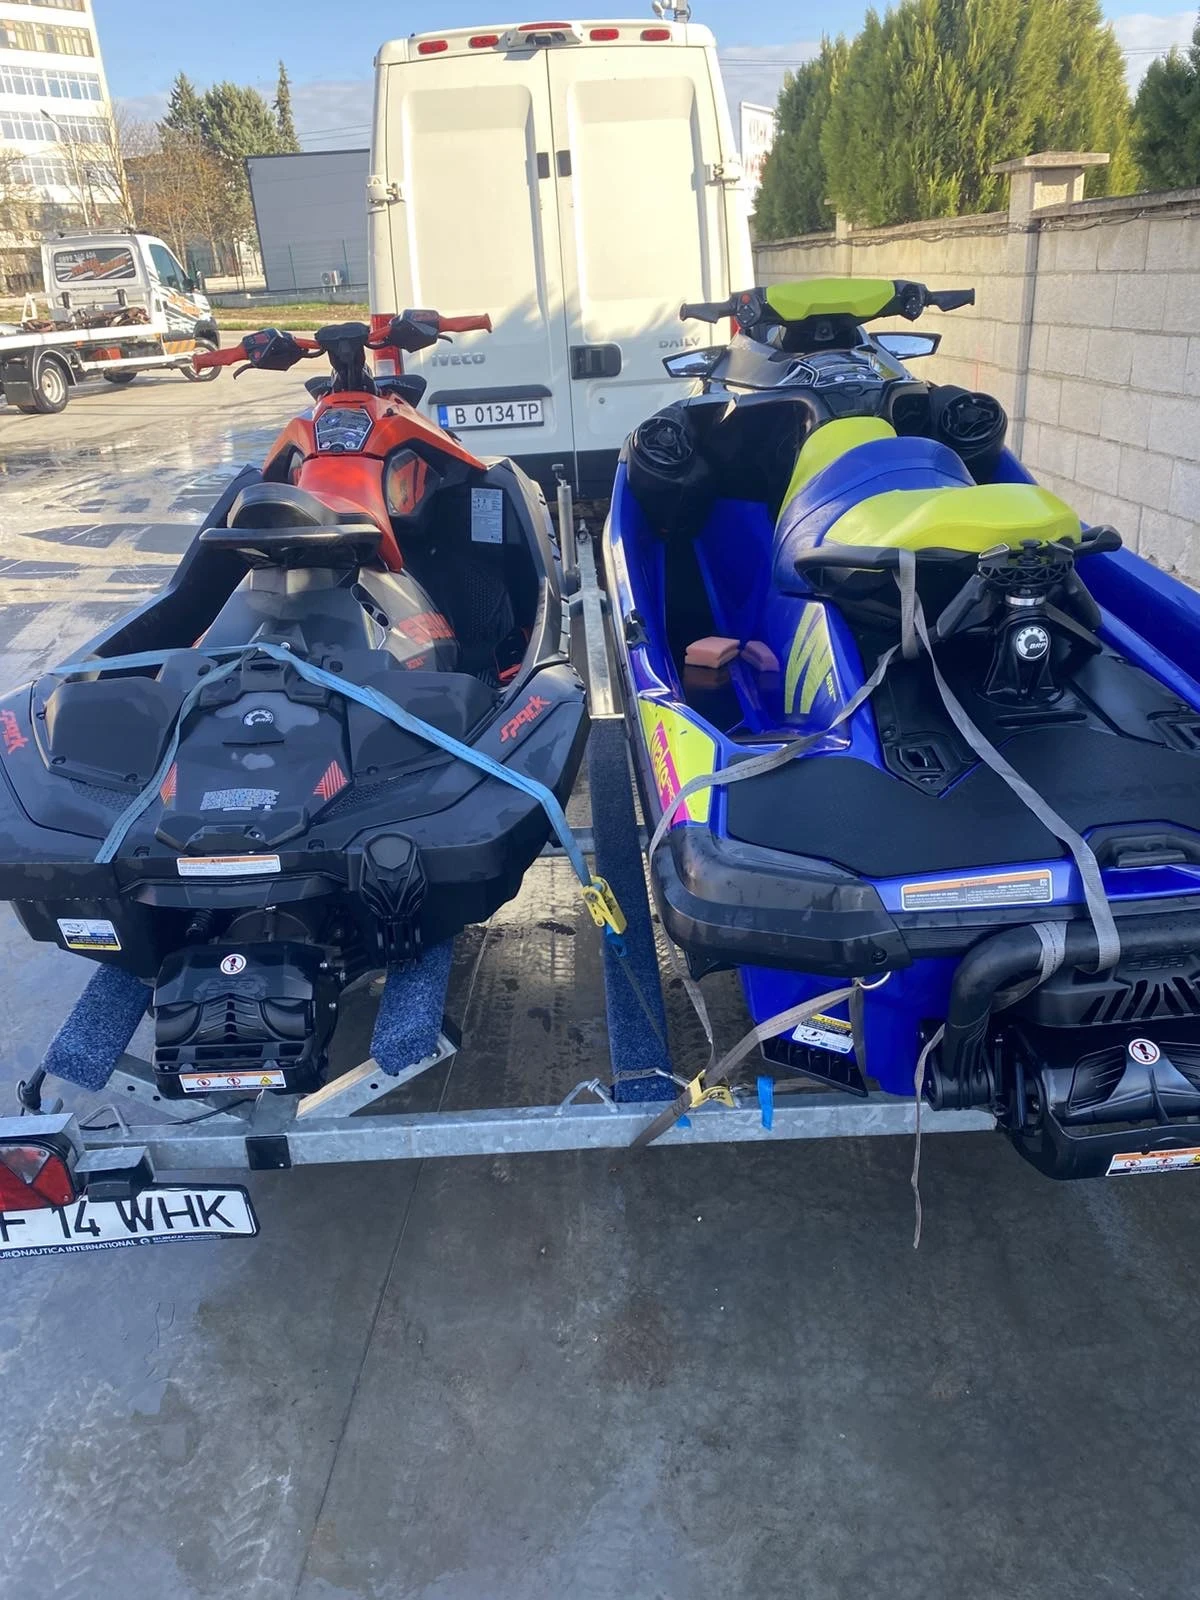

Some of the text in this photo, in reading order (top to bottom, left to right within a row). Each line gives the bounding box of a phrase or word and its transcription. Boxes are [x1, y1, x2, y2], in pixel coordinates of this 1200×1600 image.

[659, 337, 701, 348] DAILY
[431, 352, 486, 367] IVECO
[455, 403, 539, 425] B 0134 TP
[51, 1200, 100, 1238] 14
[115, 1194, 235, 1233] WHK
[66, 1240, 136, 1252] INTERNATIONAL
